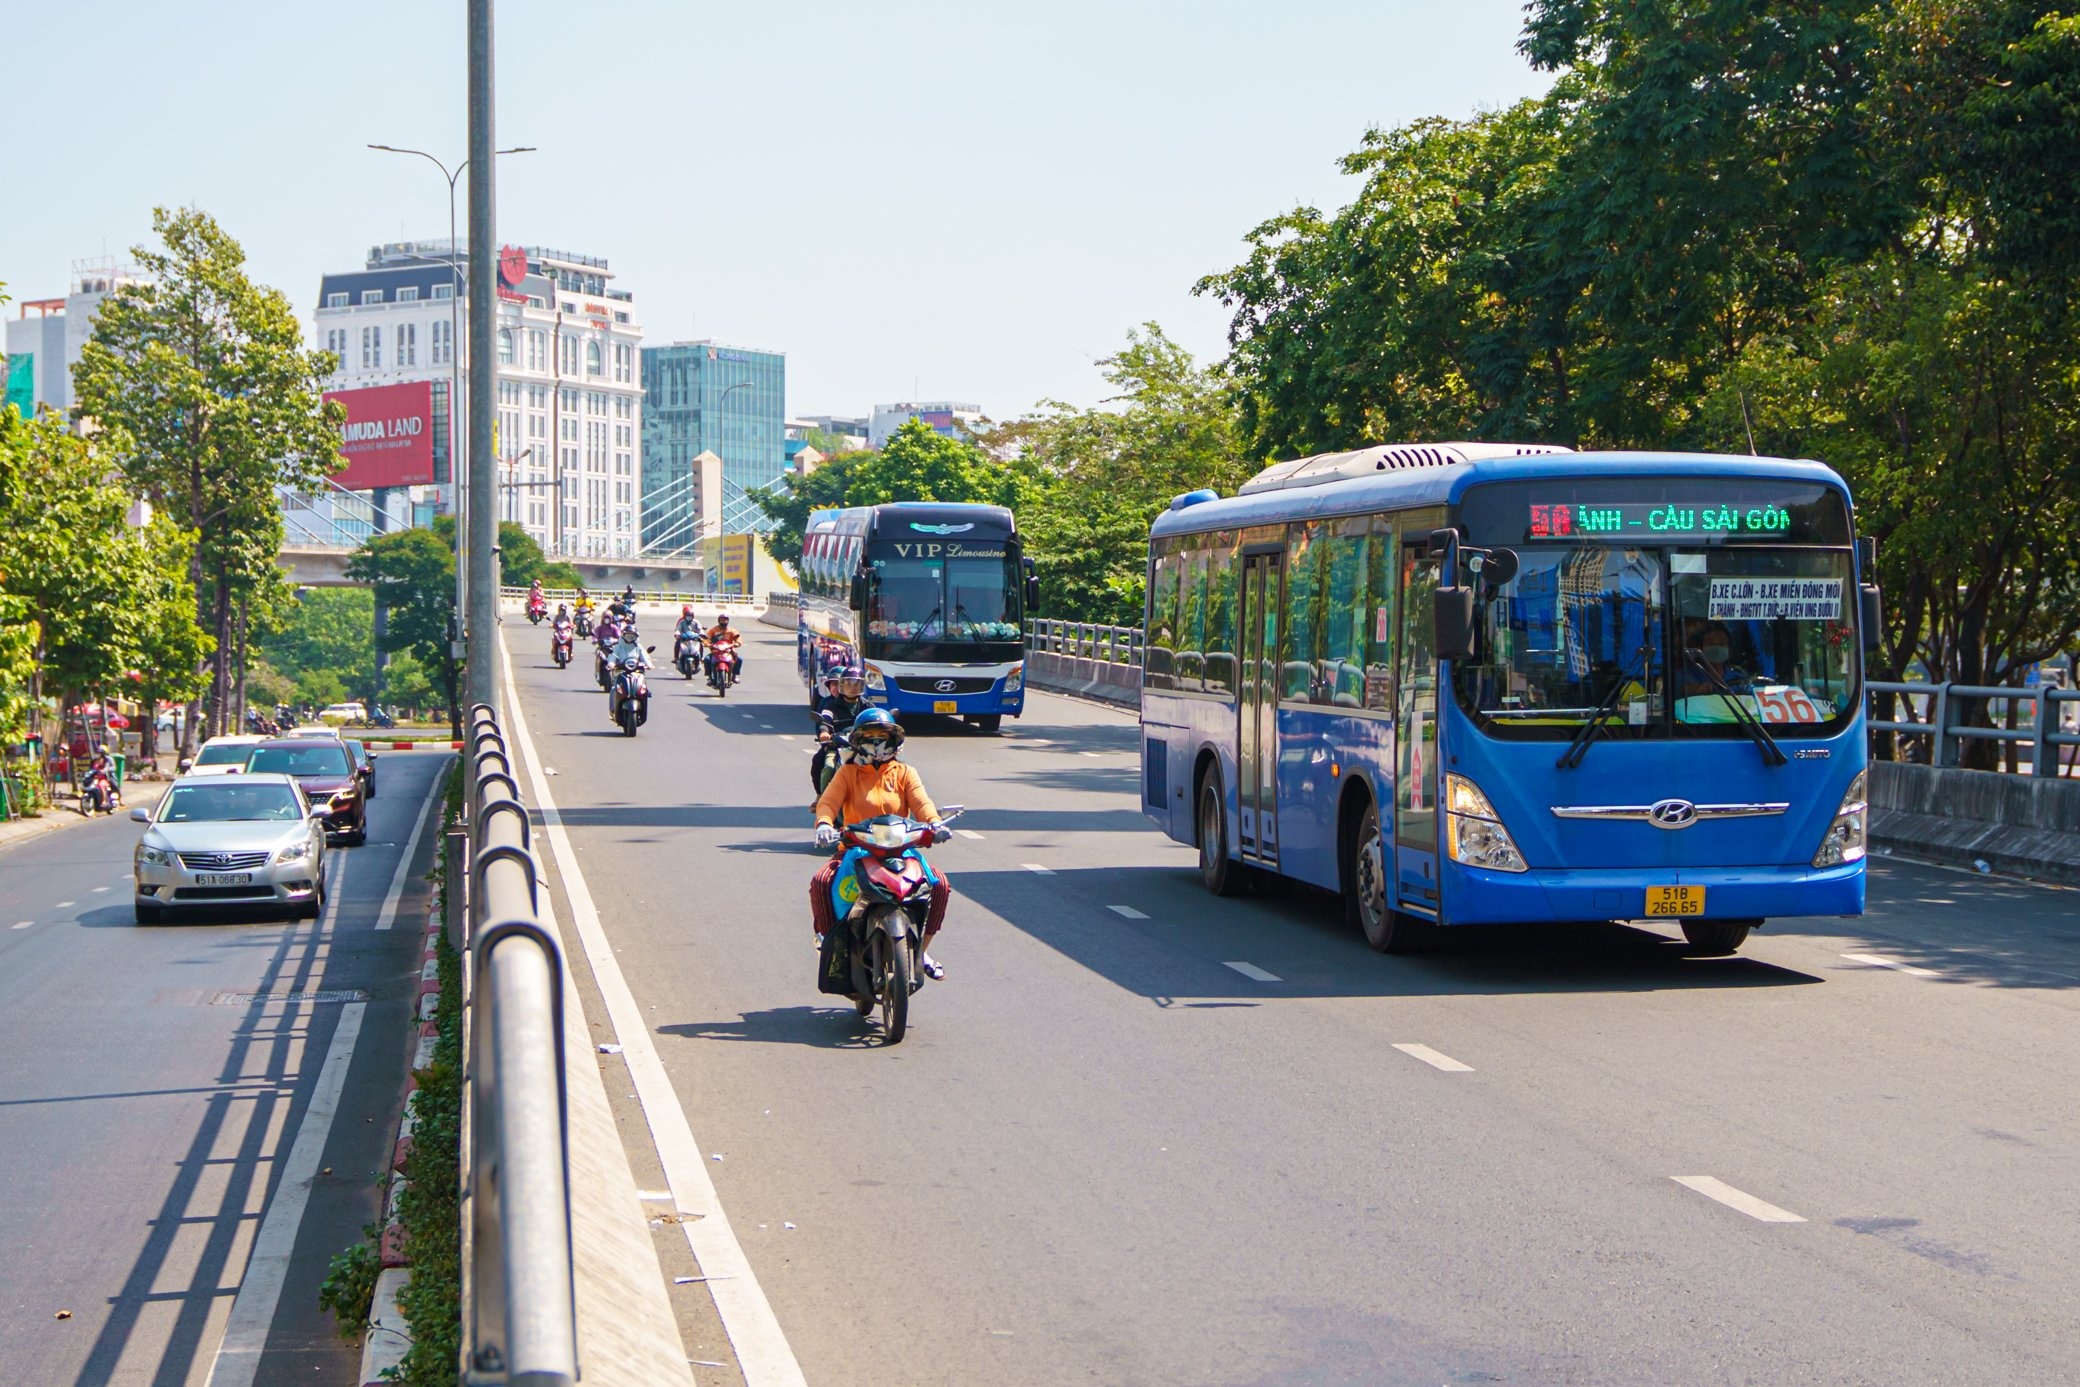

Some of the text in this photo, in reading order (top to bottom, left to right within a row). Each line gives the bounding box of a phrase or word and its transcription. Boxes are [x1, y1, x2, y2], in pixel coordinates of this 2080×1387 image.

[340, 416, 422, 442] AMUDA LAND
[894, 543, 1007, 558] VIP Limousine
[1711, 584, 1730, 599] B.XE
[1760, 584, 1778, 599] B.XE
[1756, 689, 1817, 723] 56
[1663, 887, 1688, 900] 51B
[1652, 901, 1698, 914] 266.65
